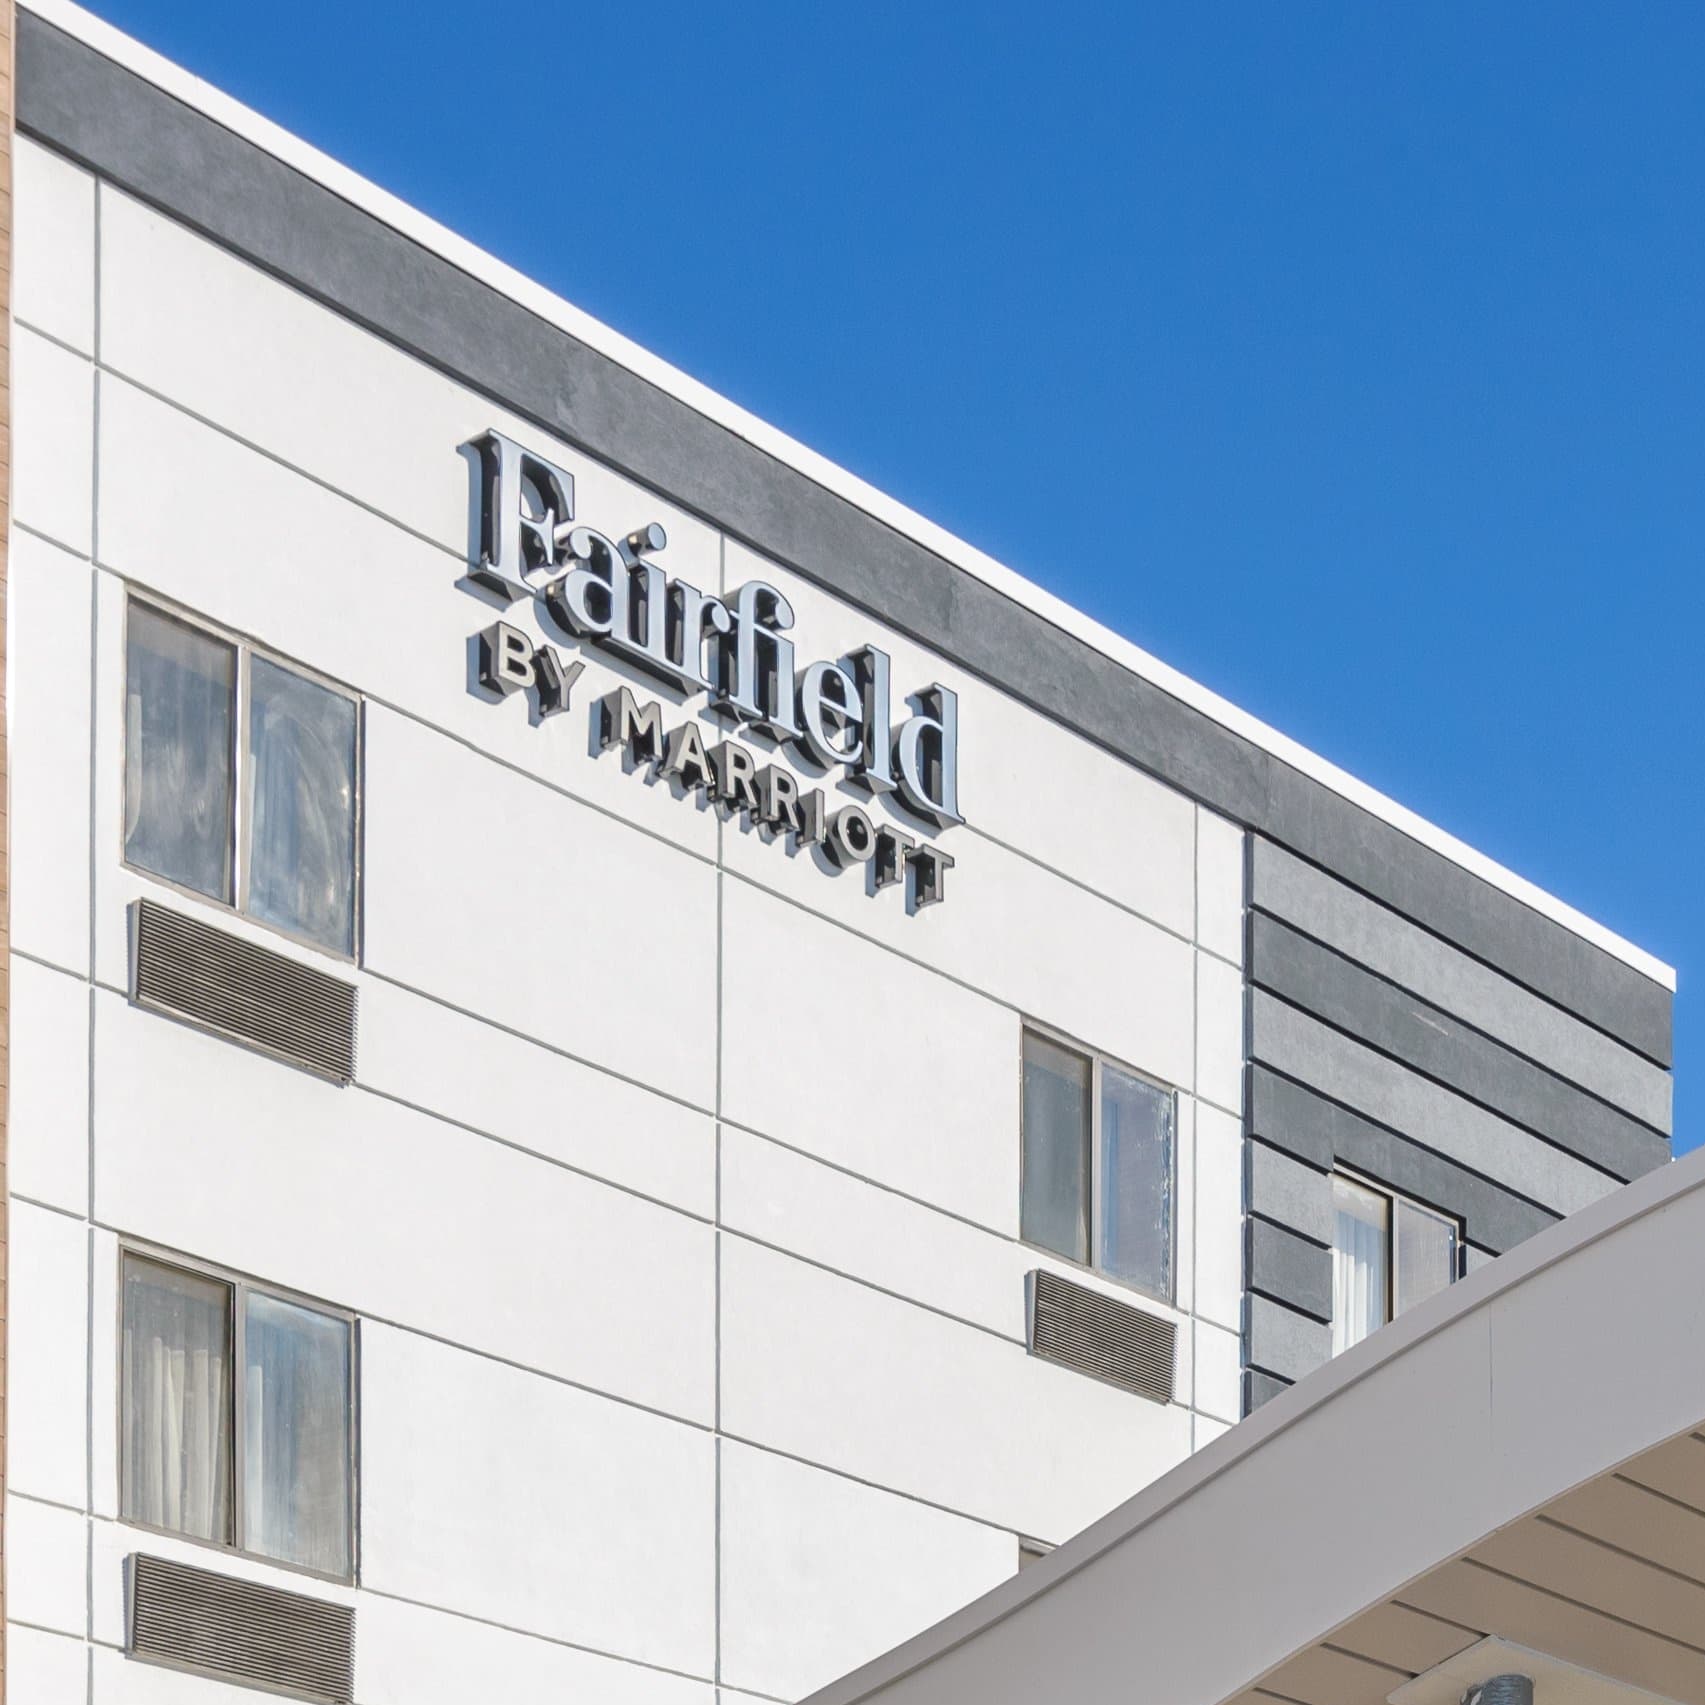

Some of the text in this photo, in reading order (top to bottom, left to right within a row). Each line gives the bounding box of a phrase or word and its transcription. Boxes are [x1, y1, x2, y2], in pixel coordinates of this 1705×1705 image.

[467, 427, 967, 829] Fairfield
[482, 620, 955, 907] BY MARRIOTT
